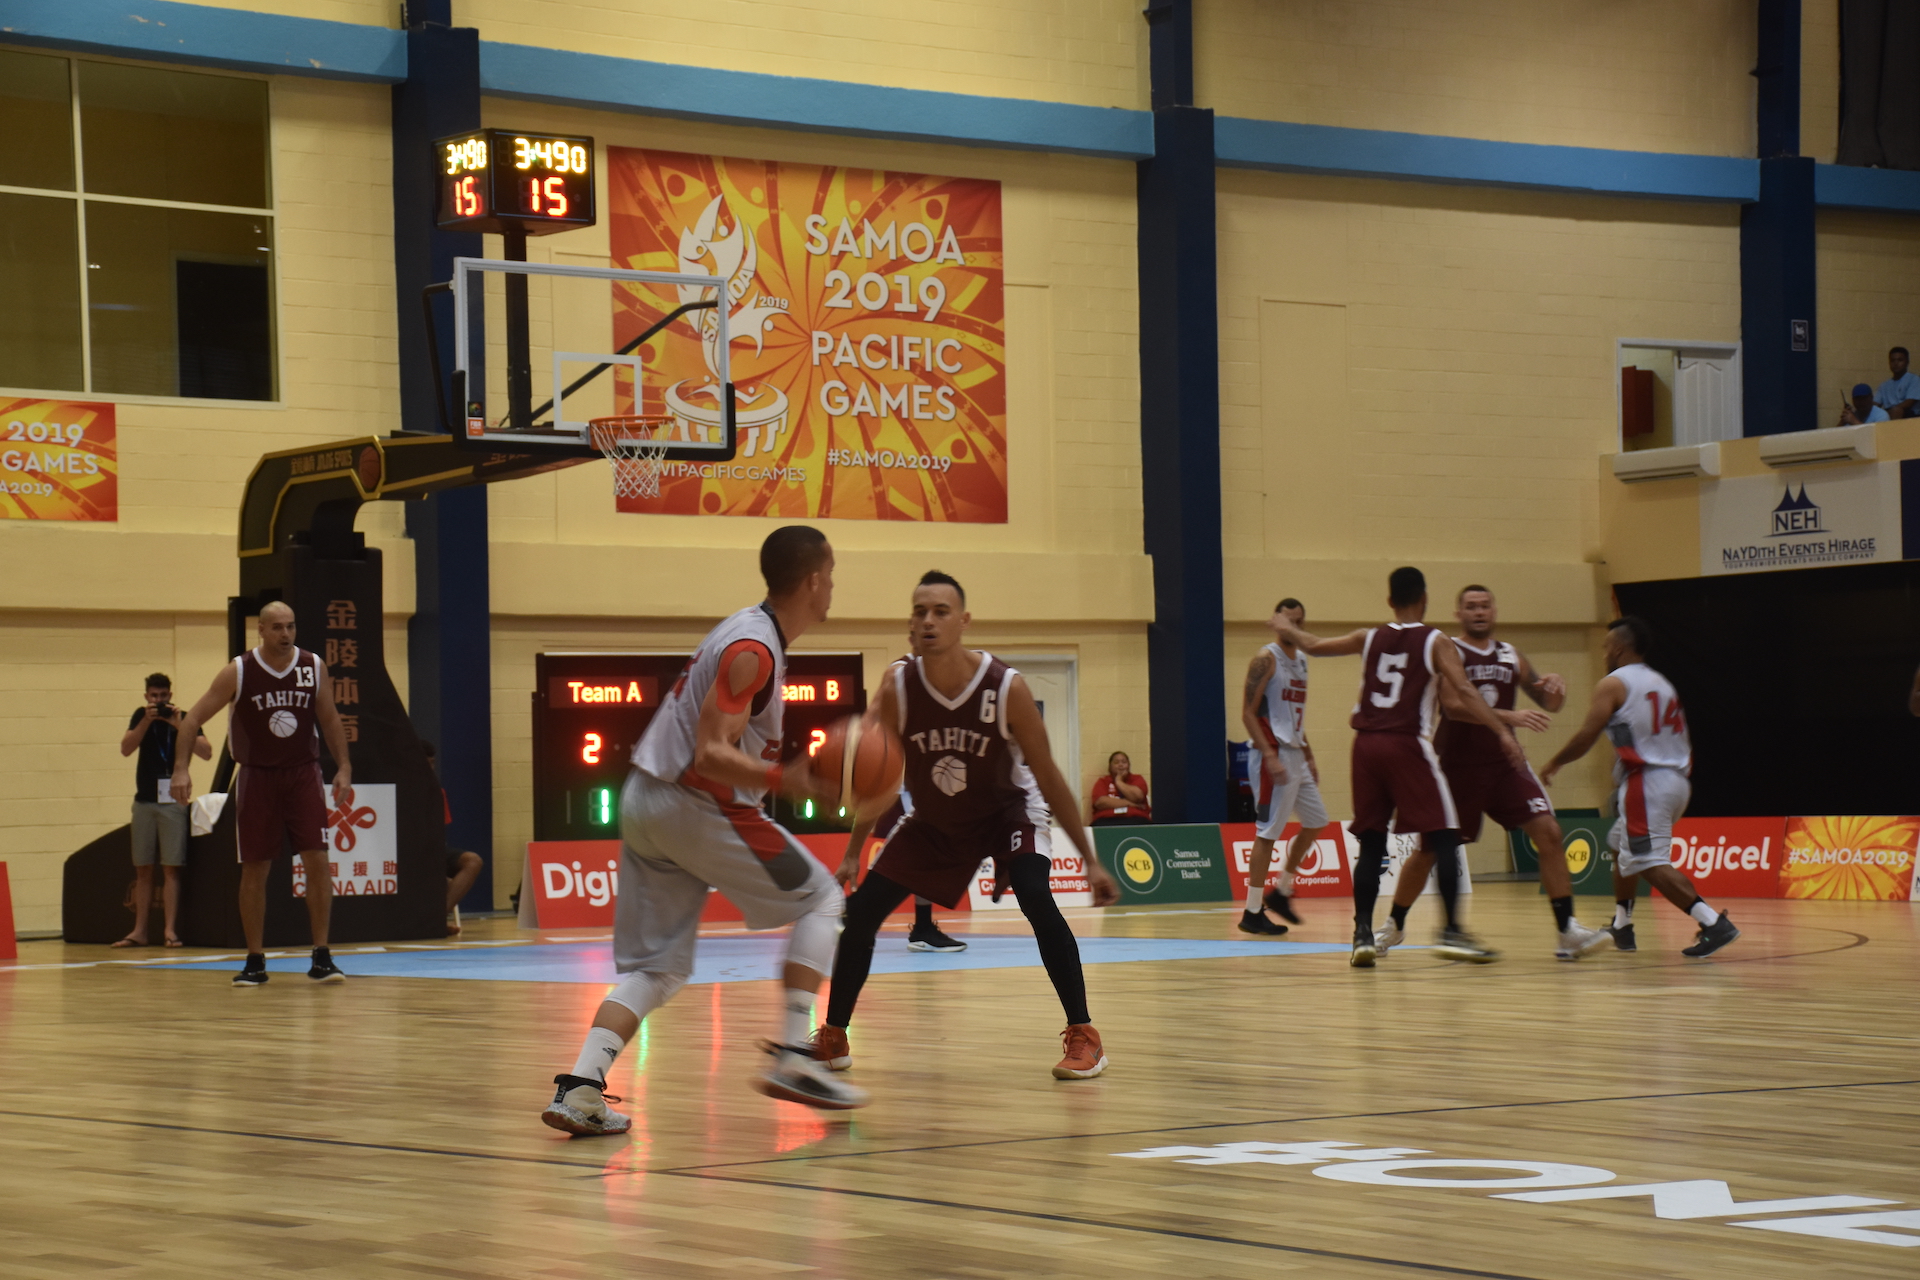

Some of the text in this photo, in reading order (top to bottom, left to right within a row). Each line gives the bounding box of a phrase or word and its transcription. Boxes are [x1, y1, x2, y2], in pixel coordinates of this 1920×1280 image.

[455, 176, 477, 216] 15
[531, 177, 568, 217] 15
[804, 214, 966, 266] SAMOA
[759, 295, 789, 310] 2019
[824, 269, 947, 322] 2019
[811, 330, 964, 374] PACIFIC
[819, 379, 957, 422] GAMES
[7, 420, 84, 448] 2019
[1, 449, 100, 475] GAMES
[827, 448, 953, 473] #SAMOA2019
[678, 464, 745, 480] PACIFIC
[746, 466, 807, 482] GAMES
[1775, 510, 1818, 532] NEH
[1779, 542, 1826, 557] EVENTS
[1828, 537, 1876, 553] HIRAGE
[294, 665, 315, 688] 13
[1370, 652, 1409, 709] 5
[250, 689, 312, 712] TAHITI
[567, 681, 643, 703] Team A
[781, 679, 840, 701] eam B
[979, 688, 998, 724] 6
[1646, 690, 1688, 736] 14
[582, 732, 602, 764] 2
[909, 726, 992, 758] TAHITI
[600, 788, 610, 825] 1
[1010, 830, 1023, 852] 6
[1166, 858, 1212, 869] Commercial
[1173, 848, 1200, 859] Samoa
[1241, 848, 1281, 864] EC
[1567, 850, 1588, 862] SCB
[1670, 835, 1771, 879] Digicel
[1788, 848, 1909, 868] #SAMOA2019
[1126, 859, 1151, 872] SCB
[1181, 869, 1202, 880] Bank
[292, 879, 397, 898] CNA AID
[542, 859, 618, 907] Digi
[1295, 875, 1340, 887] Corporation
